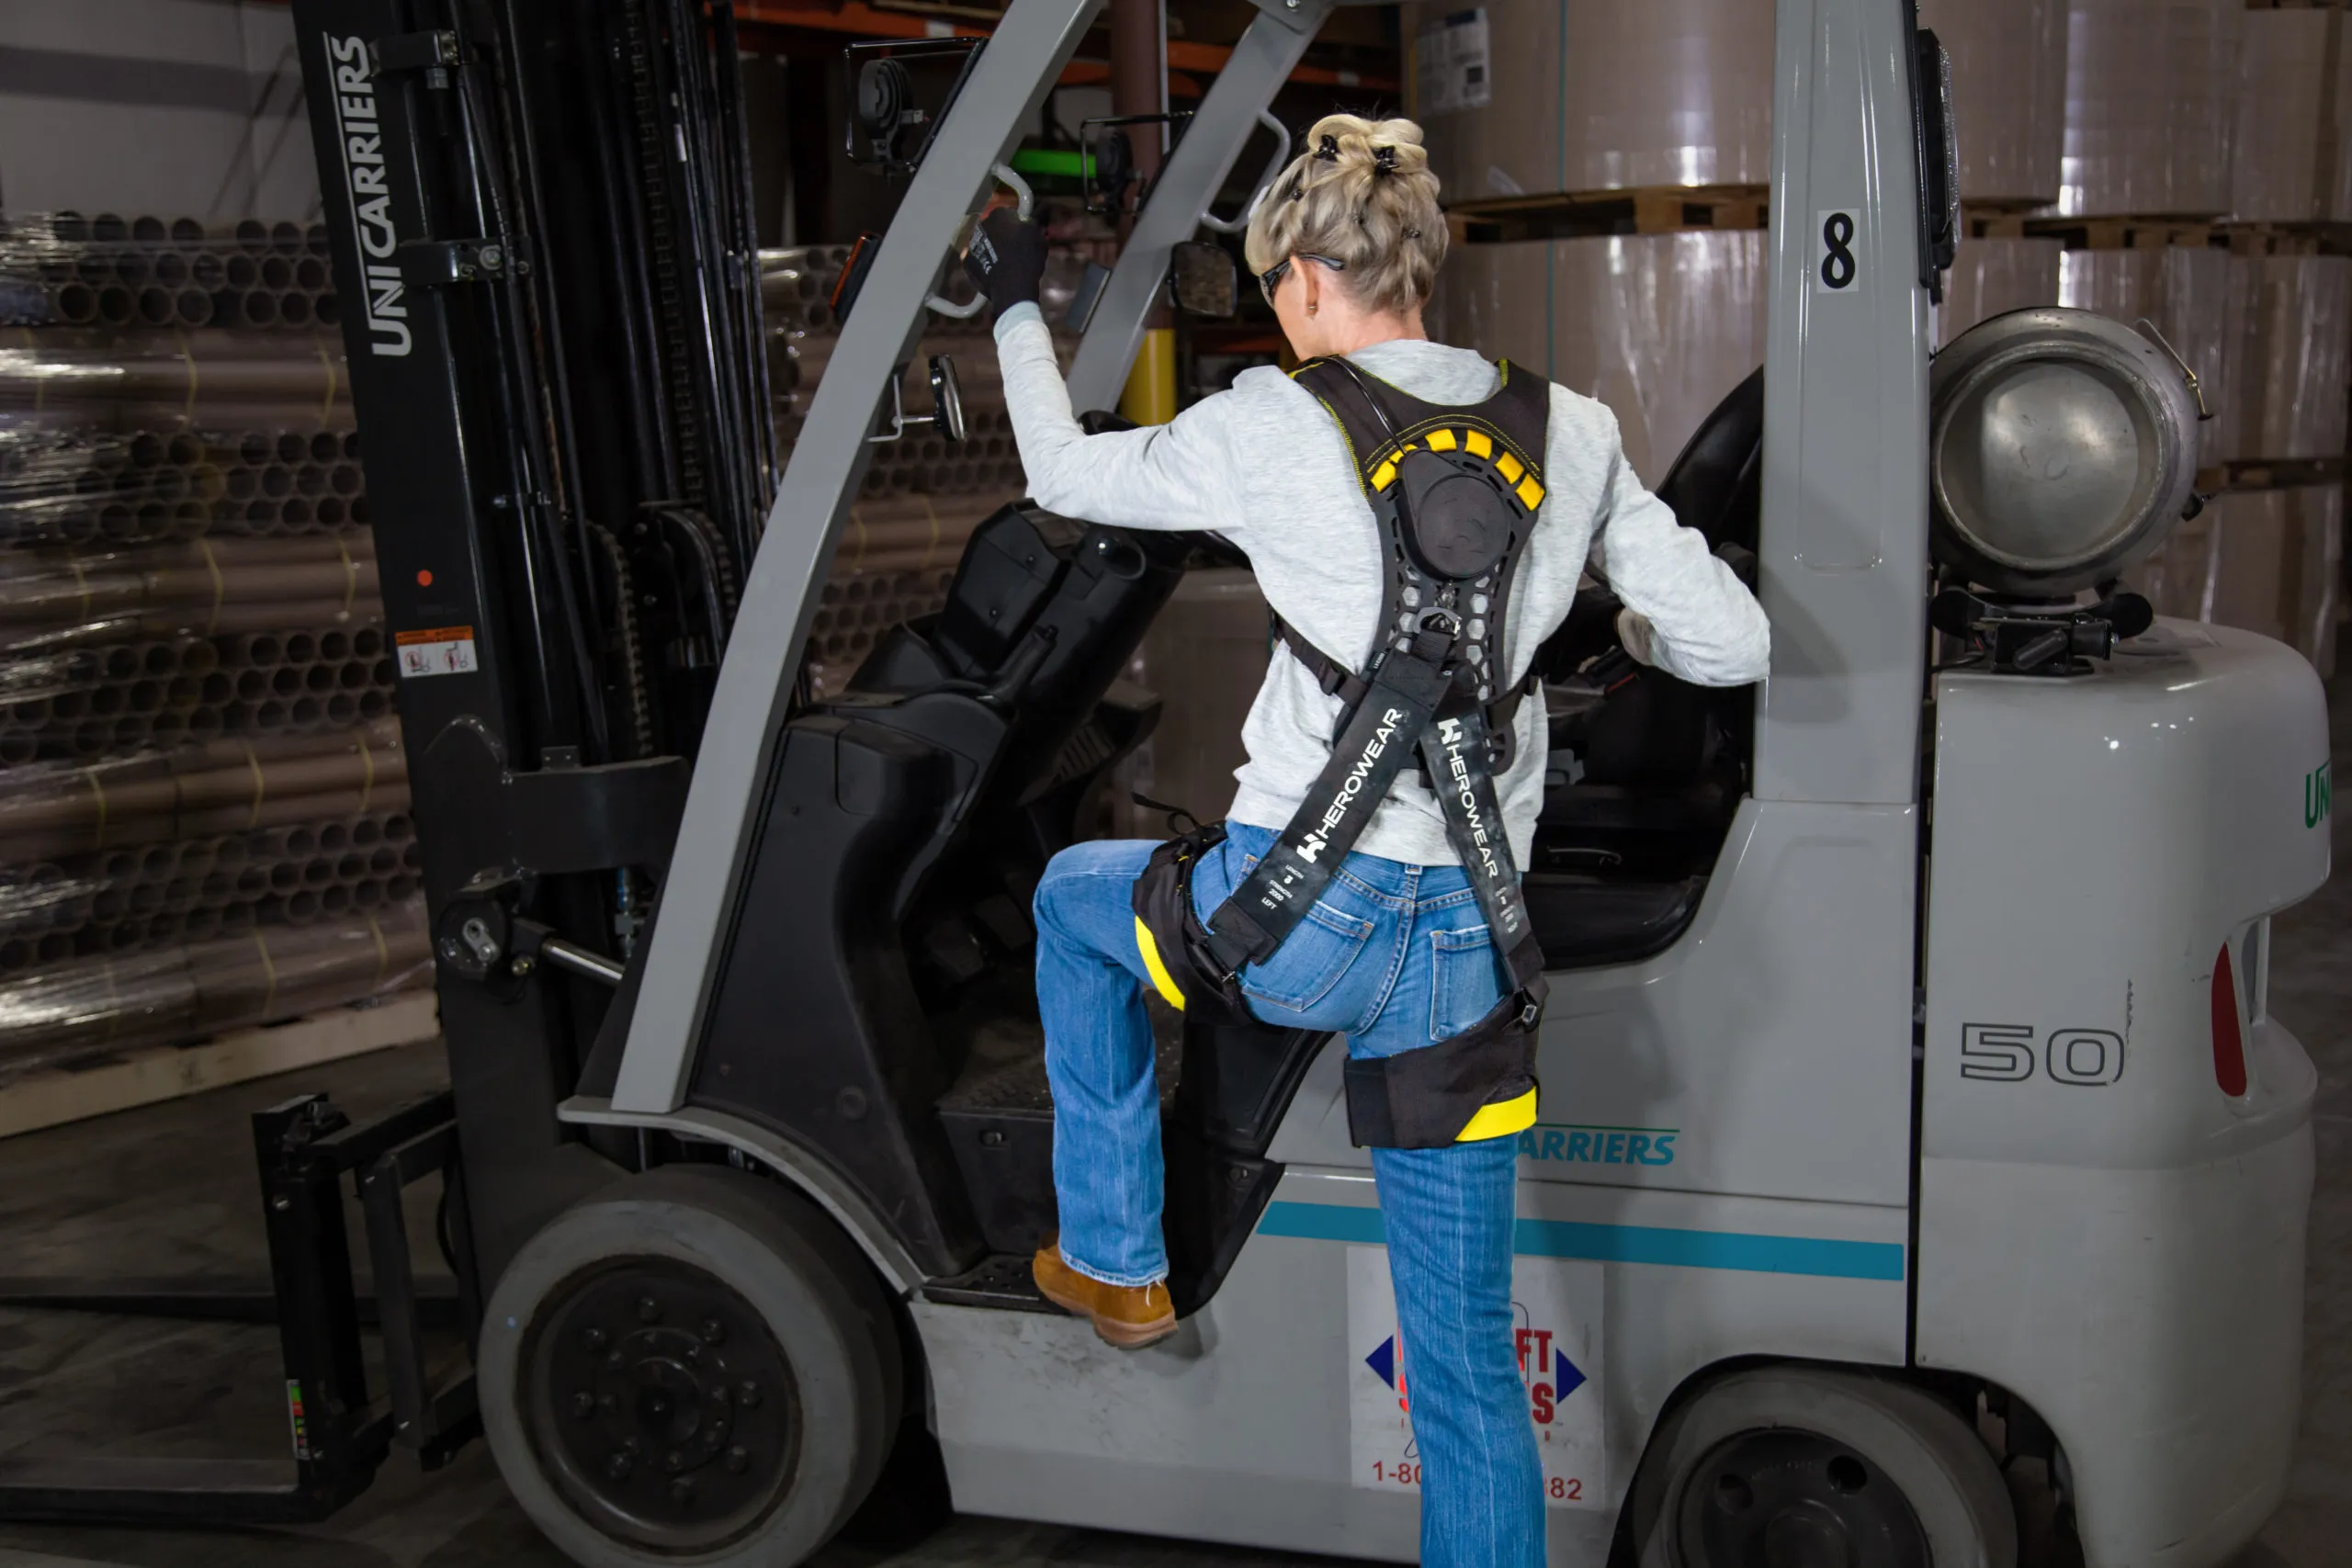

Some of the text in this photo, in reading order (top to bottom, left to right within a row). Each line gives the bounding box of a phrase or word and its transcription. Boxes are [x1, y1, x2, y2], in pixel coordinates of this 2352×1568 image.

[1821, 212, 1856, 289] 8
[1316, 708, 1403, 839] HEROWEAR
[2305, 763, 2332, 829] UN
[1447, 745, 1499, 878] HEROWEAR
[1261, 897, 1278, 909] LEFT
[1961, 1022, 2125, 1087] 50
[1518, 1128, 1677, 1167] ARRIERS
[1515, 1327, 1553, 1373] FT
